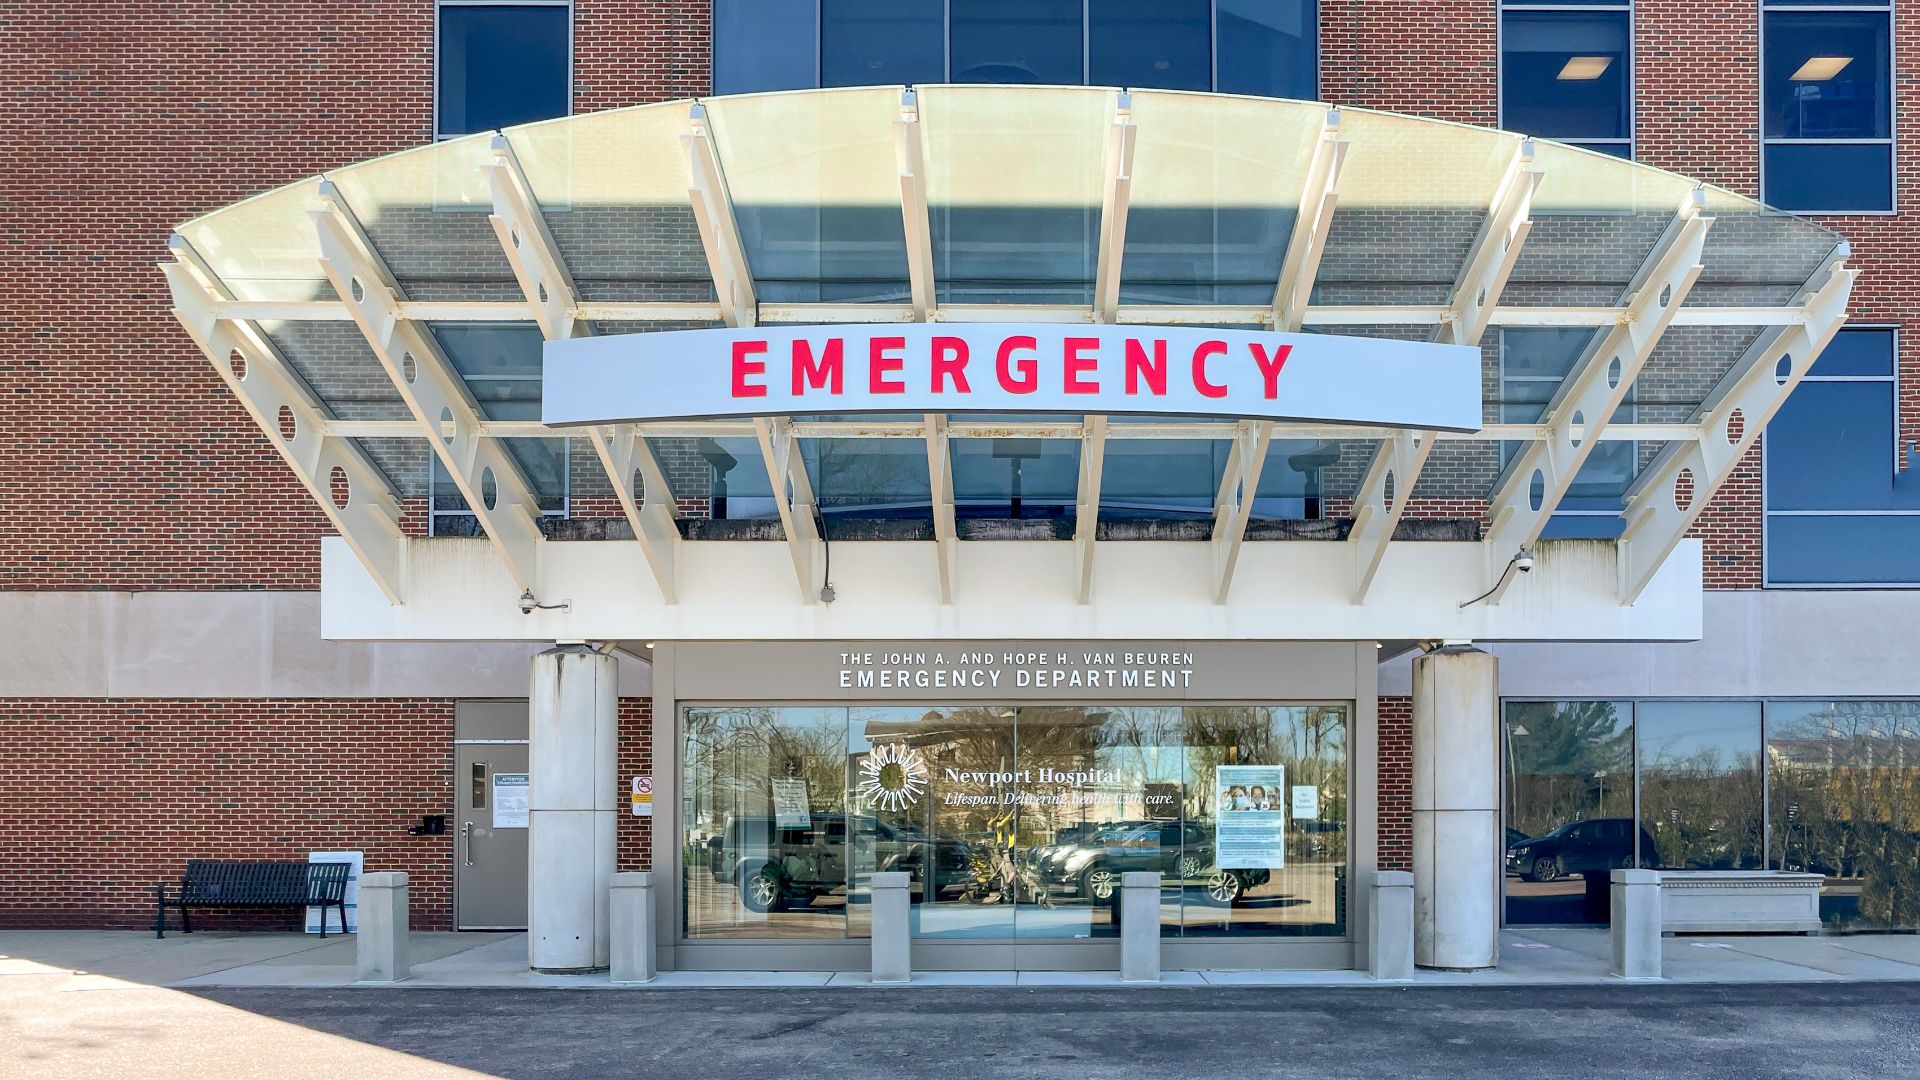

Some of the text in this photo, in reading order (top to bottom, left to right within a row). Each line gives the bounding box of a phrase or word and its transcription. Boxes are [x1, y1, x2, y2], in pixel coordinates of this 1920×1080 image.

[731, 335, 1293, 399] EMERGENCY
[840, 653, 1194, 665] THE JOHN A. AND HOPE H. VAN BEUREN
[839, 670, 1193, 688] EMERGENCY DEPARTMENT
[944, 767, 1121, 788] Newport Hospital
[943, 792, 1174, 807] Lifespan. Delivering health with care.
